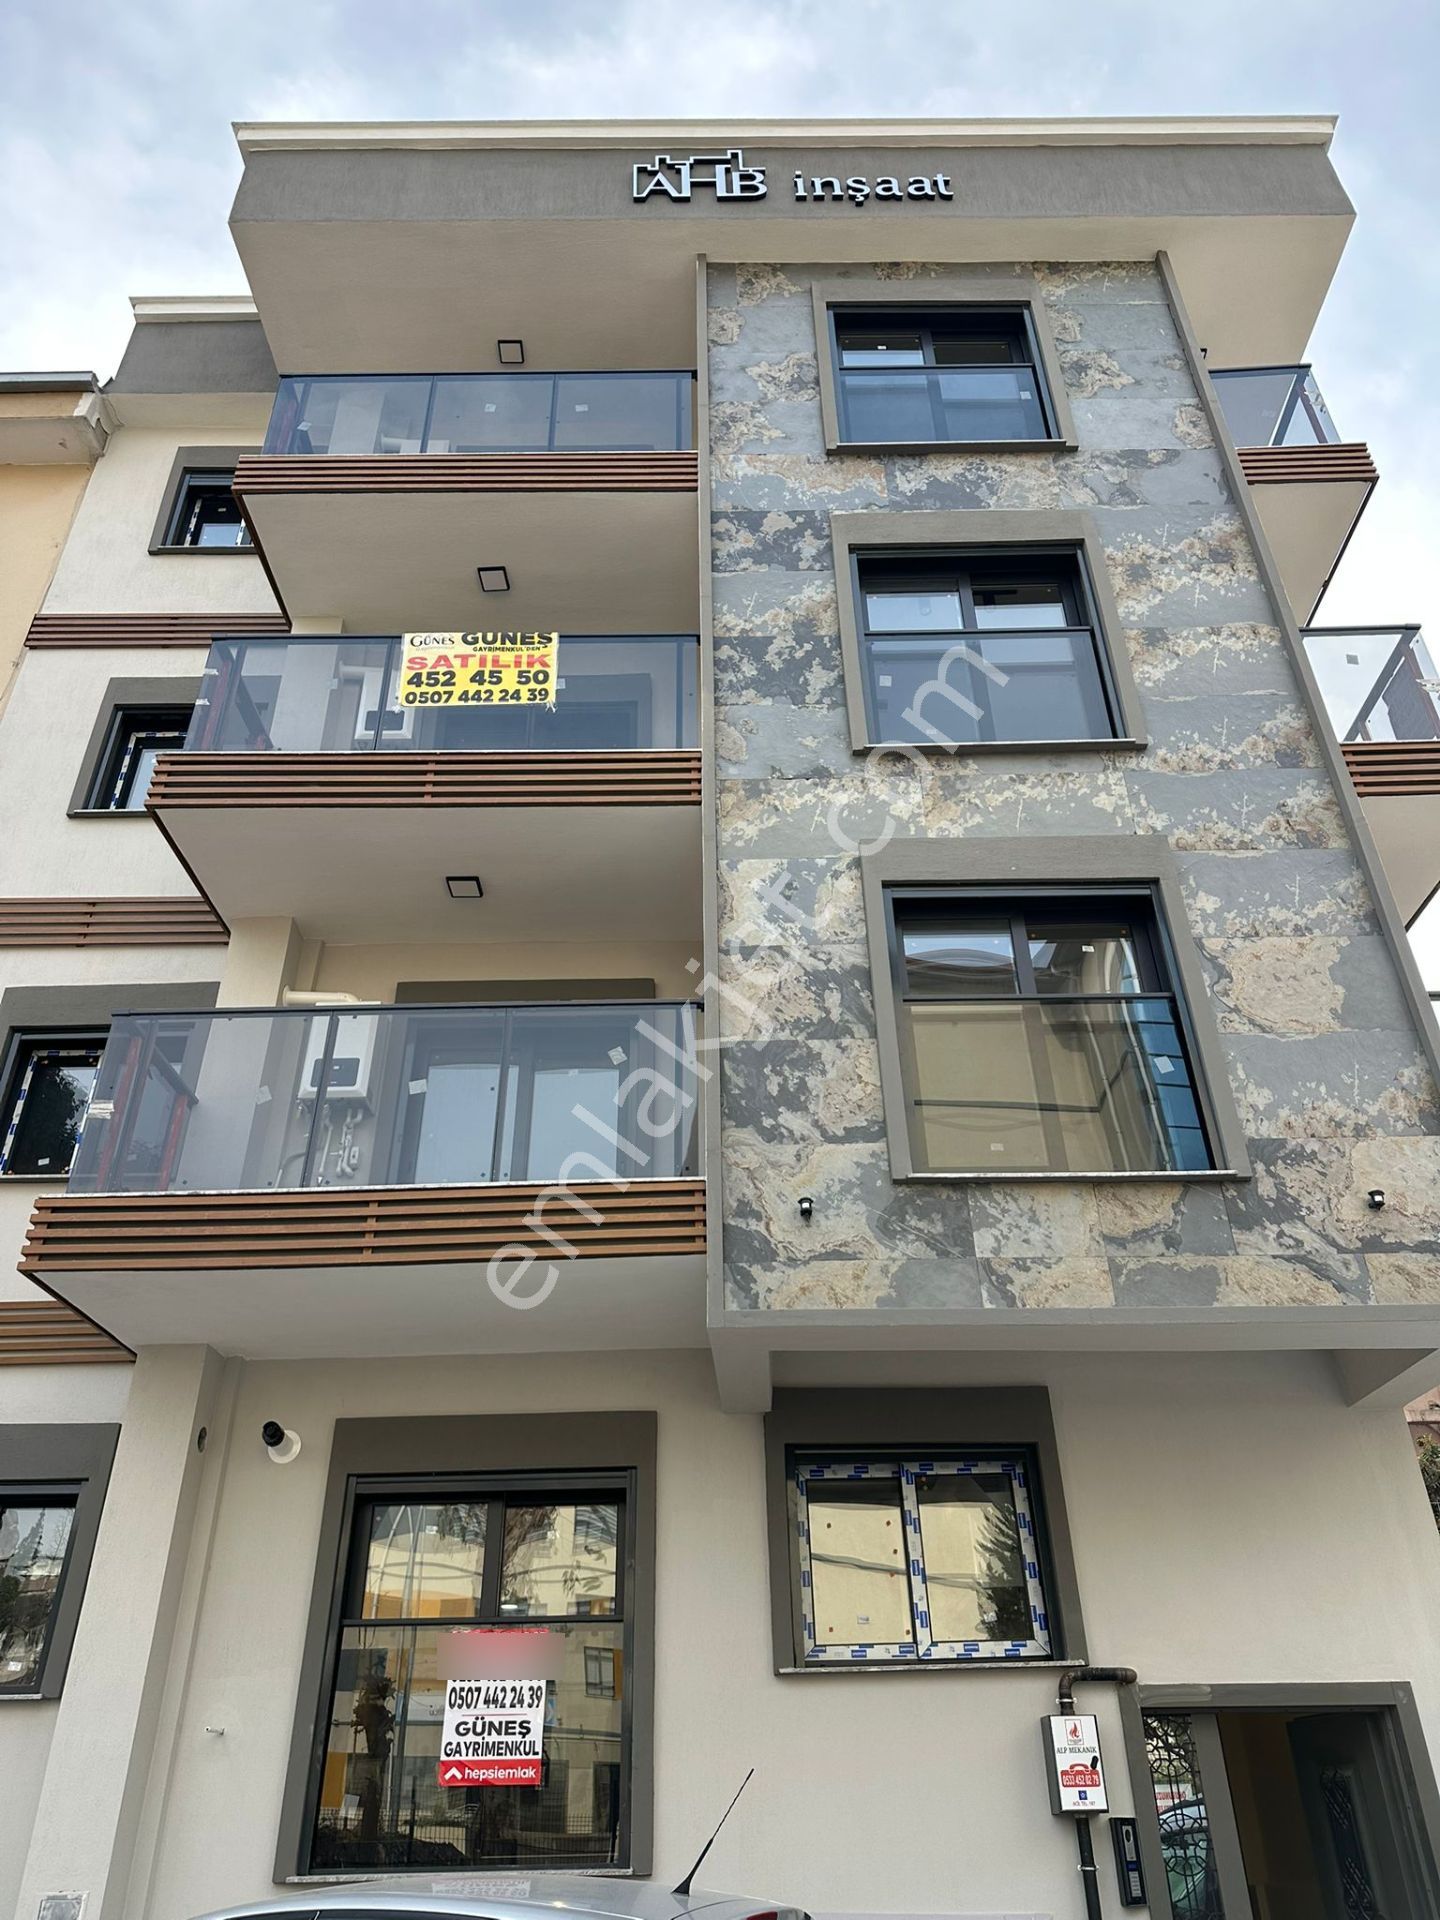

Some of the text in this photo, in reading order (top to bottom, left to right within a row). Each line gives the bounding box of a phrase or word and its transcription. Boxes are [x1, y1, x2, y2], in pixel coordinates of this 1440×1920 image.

[794, 170, 955, 207] inşaat
[406, 654, 551, 671] SATILIK
[406, 669, 549, 687] 452 45 50
[404, 687, 549, 704] 0507 442 24 39
[448, 1685, 543, 1710] 0507 442 24 39
[454, 1716, 532, 1739] GÜNEŞ
[444, 1736, 540, 1758] GAYRİMENKUL
[464, 1765, 536, 1781] hepsiemlak
